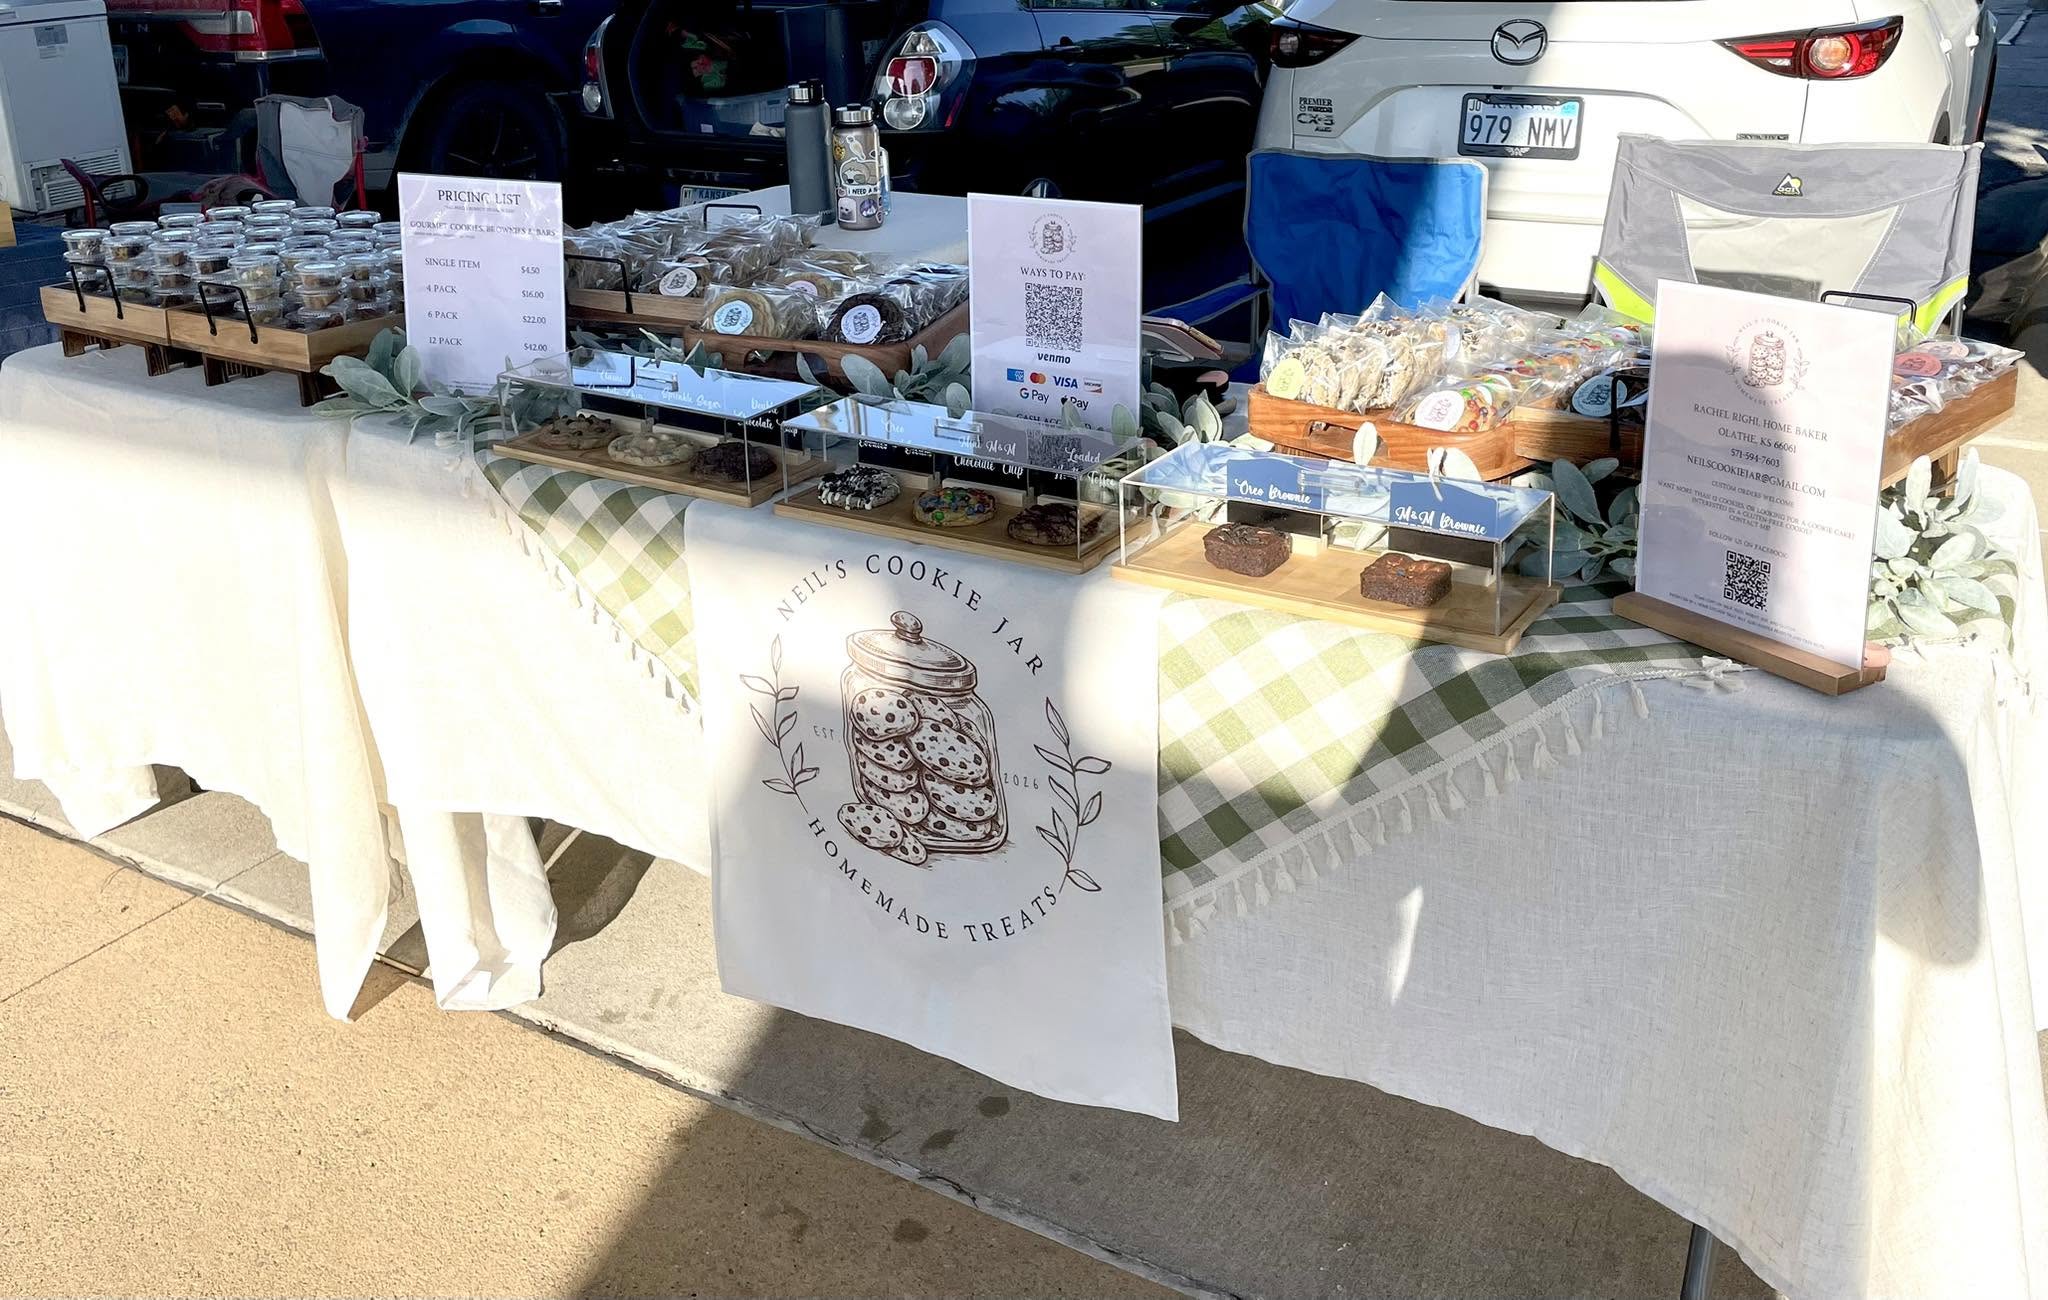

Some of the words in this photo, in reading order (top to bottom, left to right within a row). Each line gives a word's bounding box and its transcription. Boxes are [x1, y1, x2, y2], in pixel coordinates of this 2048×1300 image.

[1299, 97, 1333, 106] PREMIER
[1297, 113, 1335, 126] CX-5
[1470, 115, 1513, 143] 979
[1527, 117, 1573, 147] NMV
[438, 190, 489, 205] PRICING
[495, 193, 521, 206] LIST
[425, 258, 456, 267] SINGLE
[458, 260, 480, 269] ITEM
[521, 266, 540, 274] $4.50
[1020, 267, 1047, 278] WAYS
[1050, 269, 1063, 279] TO
[426, 285, 432, 293] 4
[434, 285, 457, 294] PACK
[522, 290, 544, 299] $16.00
[435, 312, 459, 320] PACK
[522, 316, 546, 325] $22.00
[439, 337, 463, 346] PACK
[524, 343, 547, 352] $42.00
[1037, 353, 1071, 364] venmo
[1052, 375, 1079, 389] VISA
[1020, 388, 1029, 399] G
[1032, 389, 1050, 405] Pay
[1070, 396, 1089, 411] Pay
[1694, 404, 1730, 419] RACHEL
[1763, 419, 1793, 434] HOME
[1795, 426, 1828, 442] BAKER
[986, 440, 1016, 456] M&M
[1760, 437, 1772, 448] KS
[1773, 441, 1797, 454] 66061
[1065, 447, 1100, 463] Loaded
[1730, 448, 1780, 468] 571-594-7603
[1687, 454, 1826, 498] NEILSCOOKIEJAR@GMAIL.COM
[1235, 479, 1264, 496] Oreo
[1268, 484, 1312, 505] Brownie
[1395, 506, 1435, 526] M&M
[1440, 513, 1487, 535] Brownie
[777, 559, 848, 623] NEIL'S
[866, 554, 982, 612] COOKIE
[992, 617, 1043, 677] JAR
[1003, 772, 1040, 790] 2026
[807, 817, 949, 940] HOMEMADE
[963, 885, 1057, 943] TREATS
